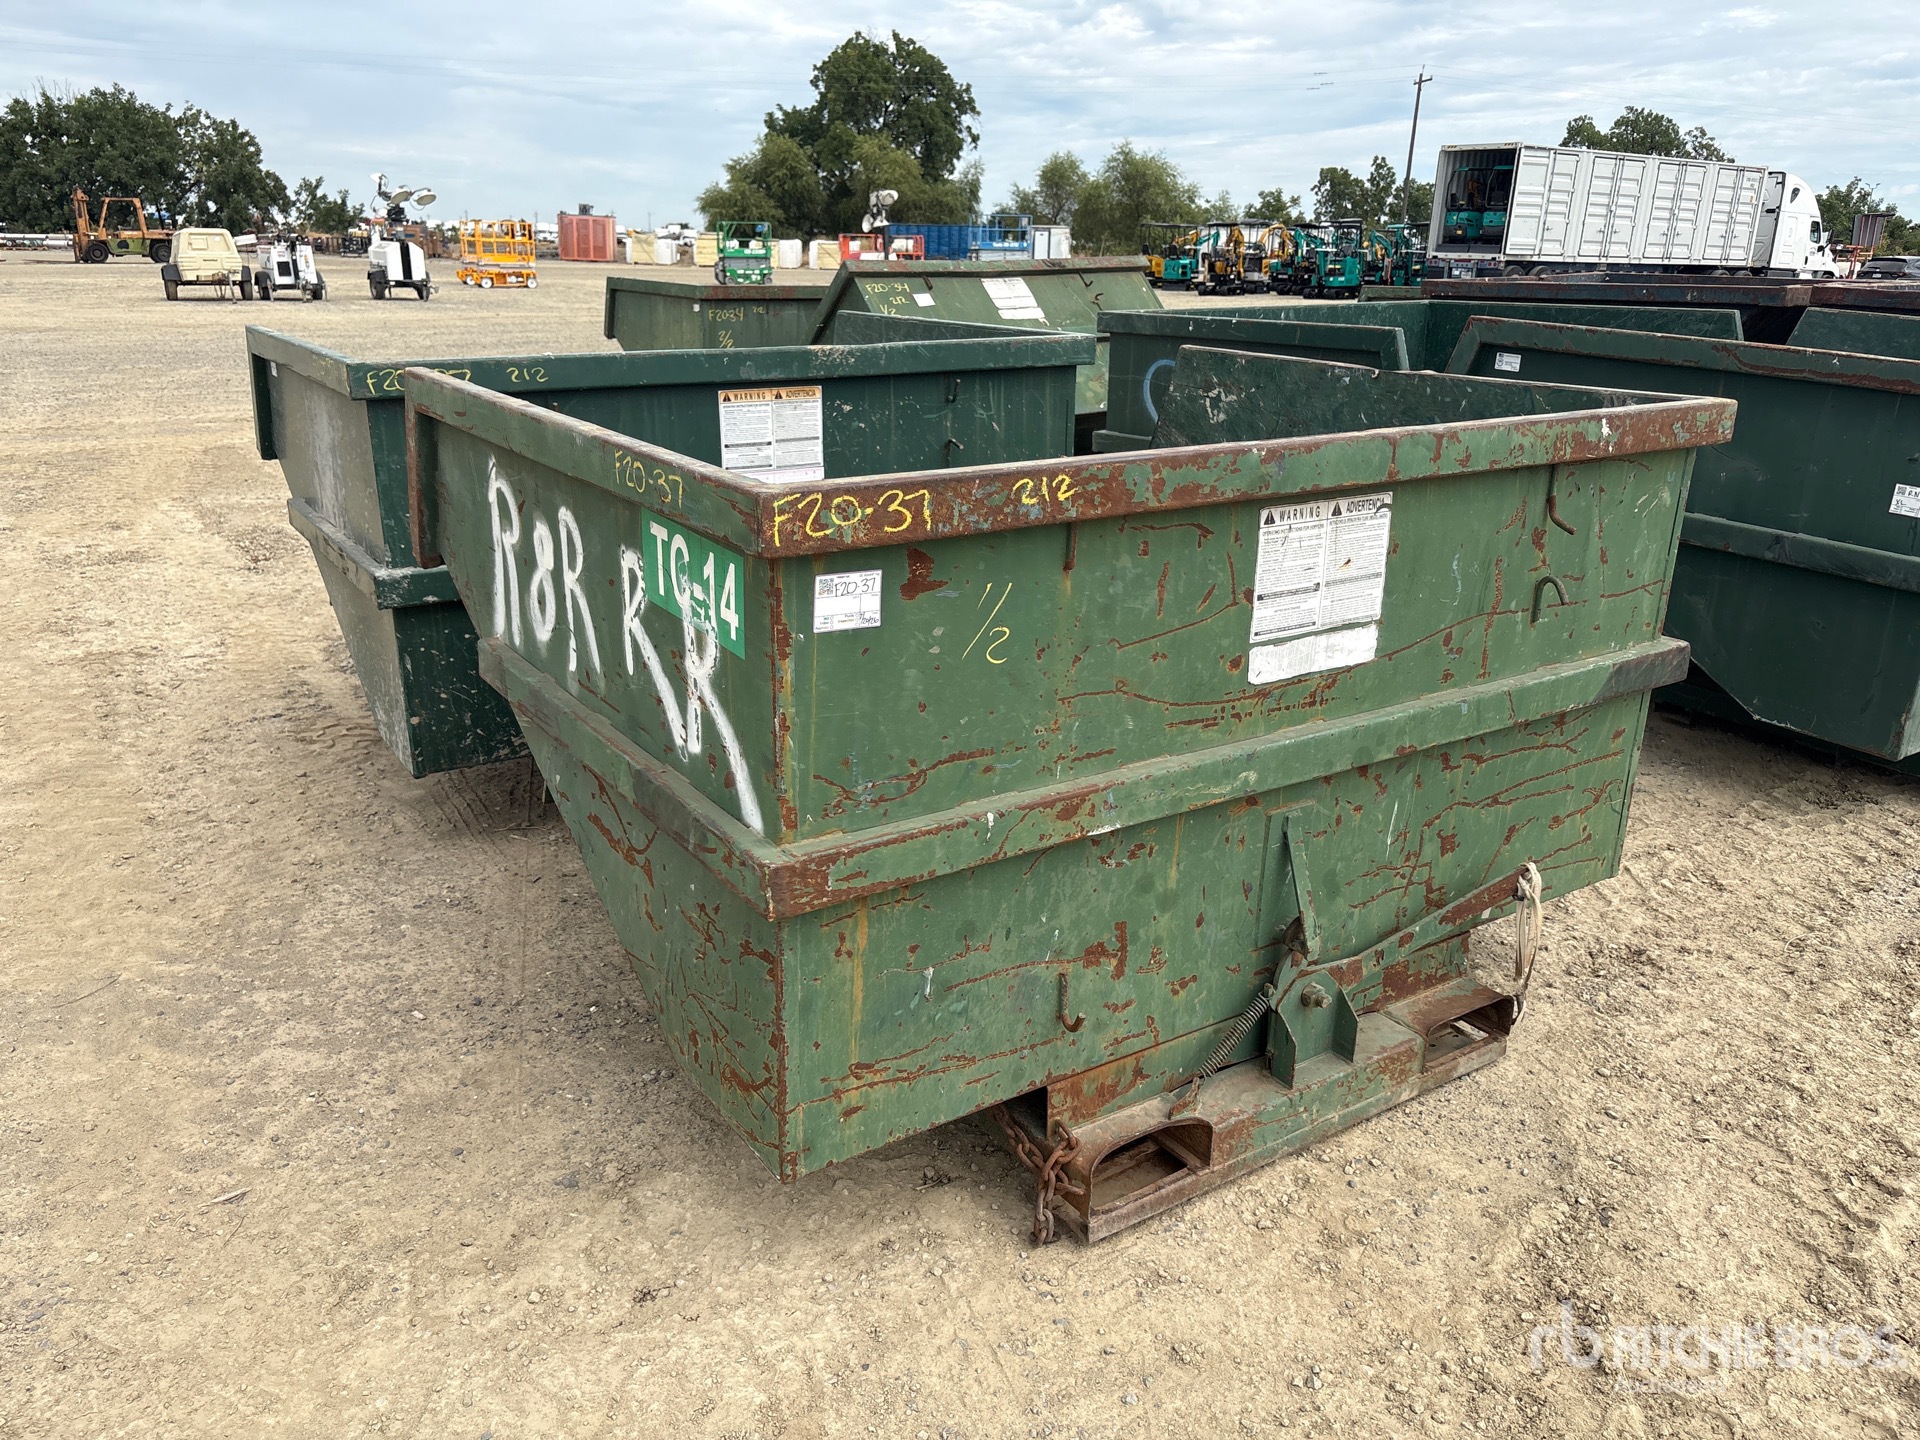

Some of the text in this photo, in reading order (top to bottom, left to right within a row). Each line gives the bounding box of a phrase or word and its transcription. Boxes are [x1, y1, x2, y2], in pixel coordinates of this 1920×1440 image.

[864, 282, 910, 294] F20-34
[506, 366, 549, 383] 212
[734, 391, 766, 401] WARNING
[785, 389, 817, 399] ADVERTENCIA
[615, 448, 684, 511] F20-37
[772, 474, 1078, 547] F20-37 212
[1279, 505, 1321, 523] WARNING
[649, 520, 741, 642] TC-14
[834, 577, 876, 598] F20-37
[962, 582, 1013, 665] 1/2
